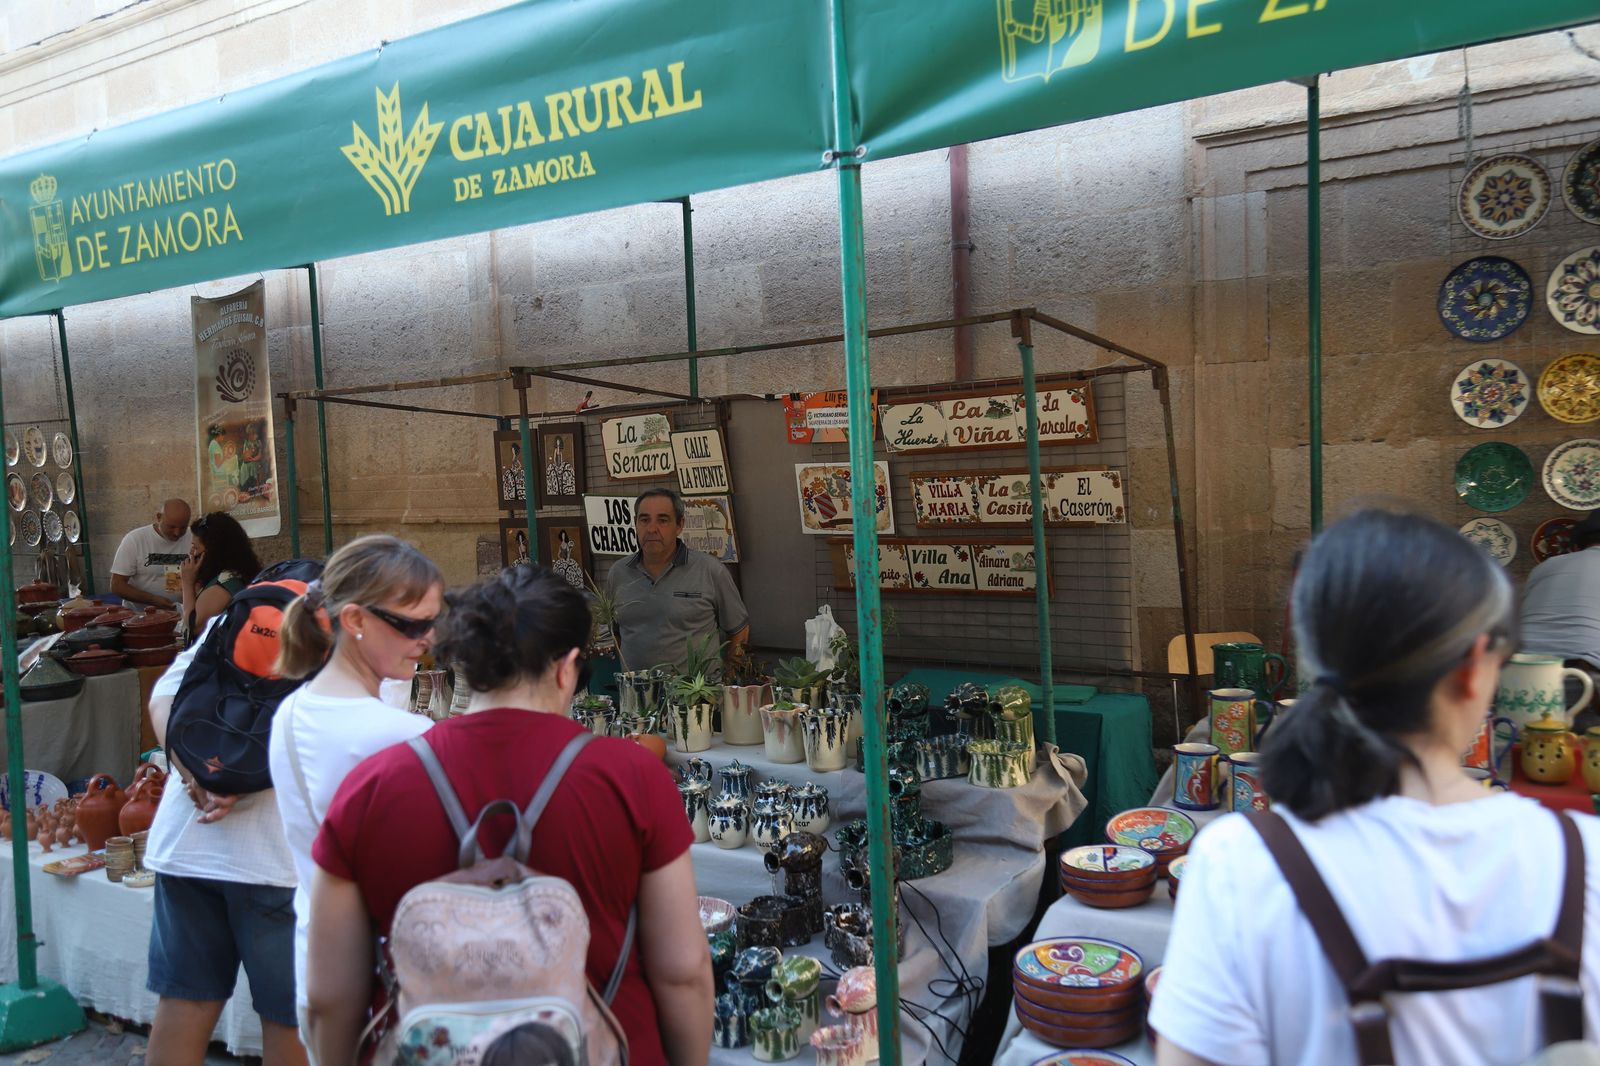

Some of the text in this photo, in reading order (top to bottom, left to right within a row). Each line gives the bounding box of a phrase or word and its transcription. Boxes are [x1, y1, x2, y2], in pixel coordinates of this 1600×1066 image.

[450, 61, 702, 161] CAJA RURAL
[453, 151, 596, 202] DE ZAMORA
[71, 159, 237, 226] AYUNTAMIENTO
[75, 203, 244, 273] DE ZAMORA
[949, 400, 984, 420] La
[1042, 392, 1059, 412] La
[900, 406, 924, 425] La
[1037, 414, 1077, 434] arcela
[616, 422, 638, 444] La
[894, 429, 938, 445] Huerta
[953, 425, 1013, 444] Viña
[684, 436, 711, 460] CALLE
[612, 452, 672, 475] Senara
[680, 465, 726, 489] LA FUENTE
[1077, 477, 1092, 496] El
[928, 483, 963, 498] VILLA
[988, 483, 1009, 497] La
[604, 499, 632, 525] LOS
[928, 502, 969, 517] MARIA
[1060, 498, 1114, 517] Caserón
[591, 526, 639, 552] CHARC
[911, 550, 947, 565] Villa
[979, 555, 1010, 568] Ainara
[938, 569, 971, 585] Ana
[988, 573, 1024, 587] Adriana
